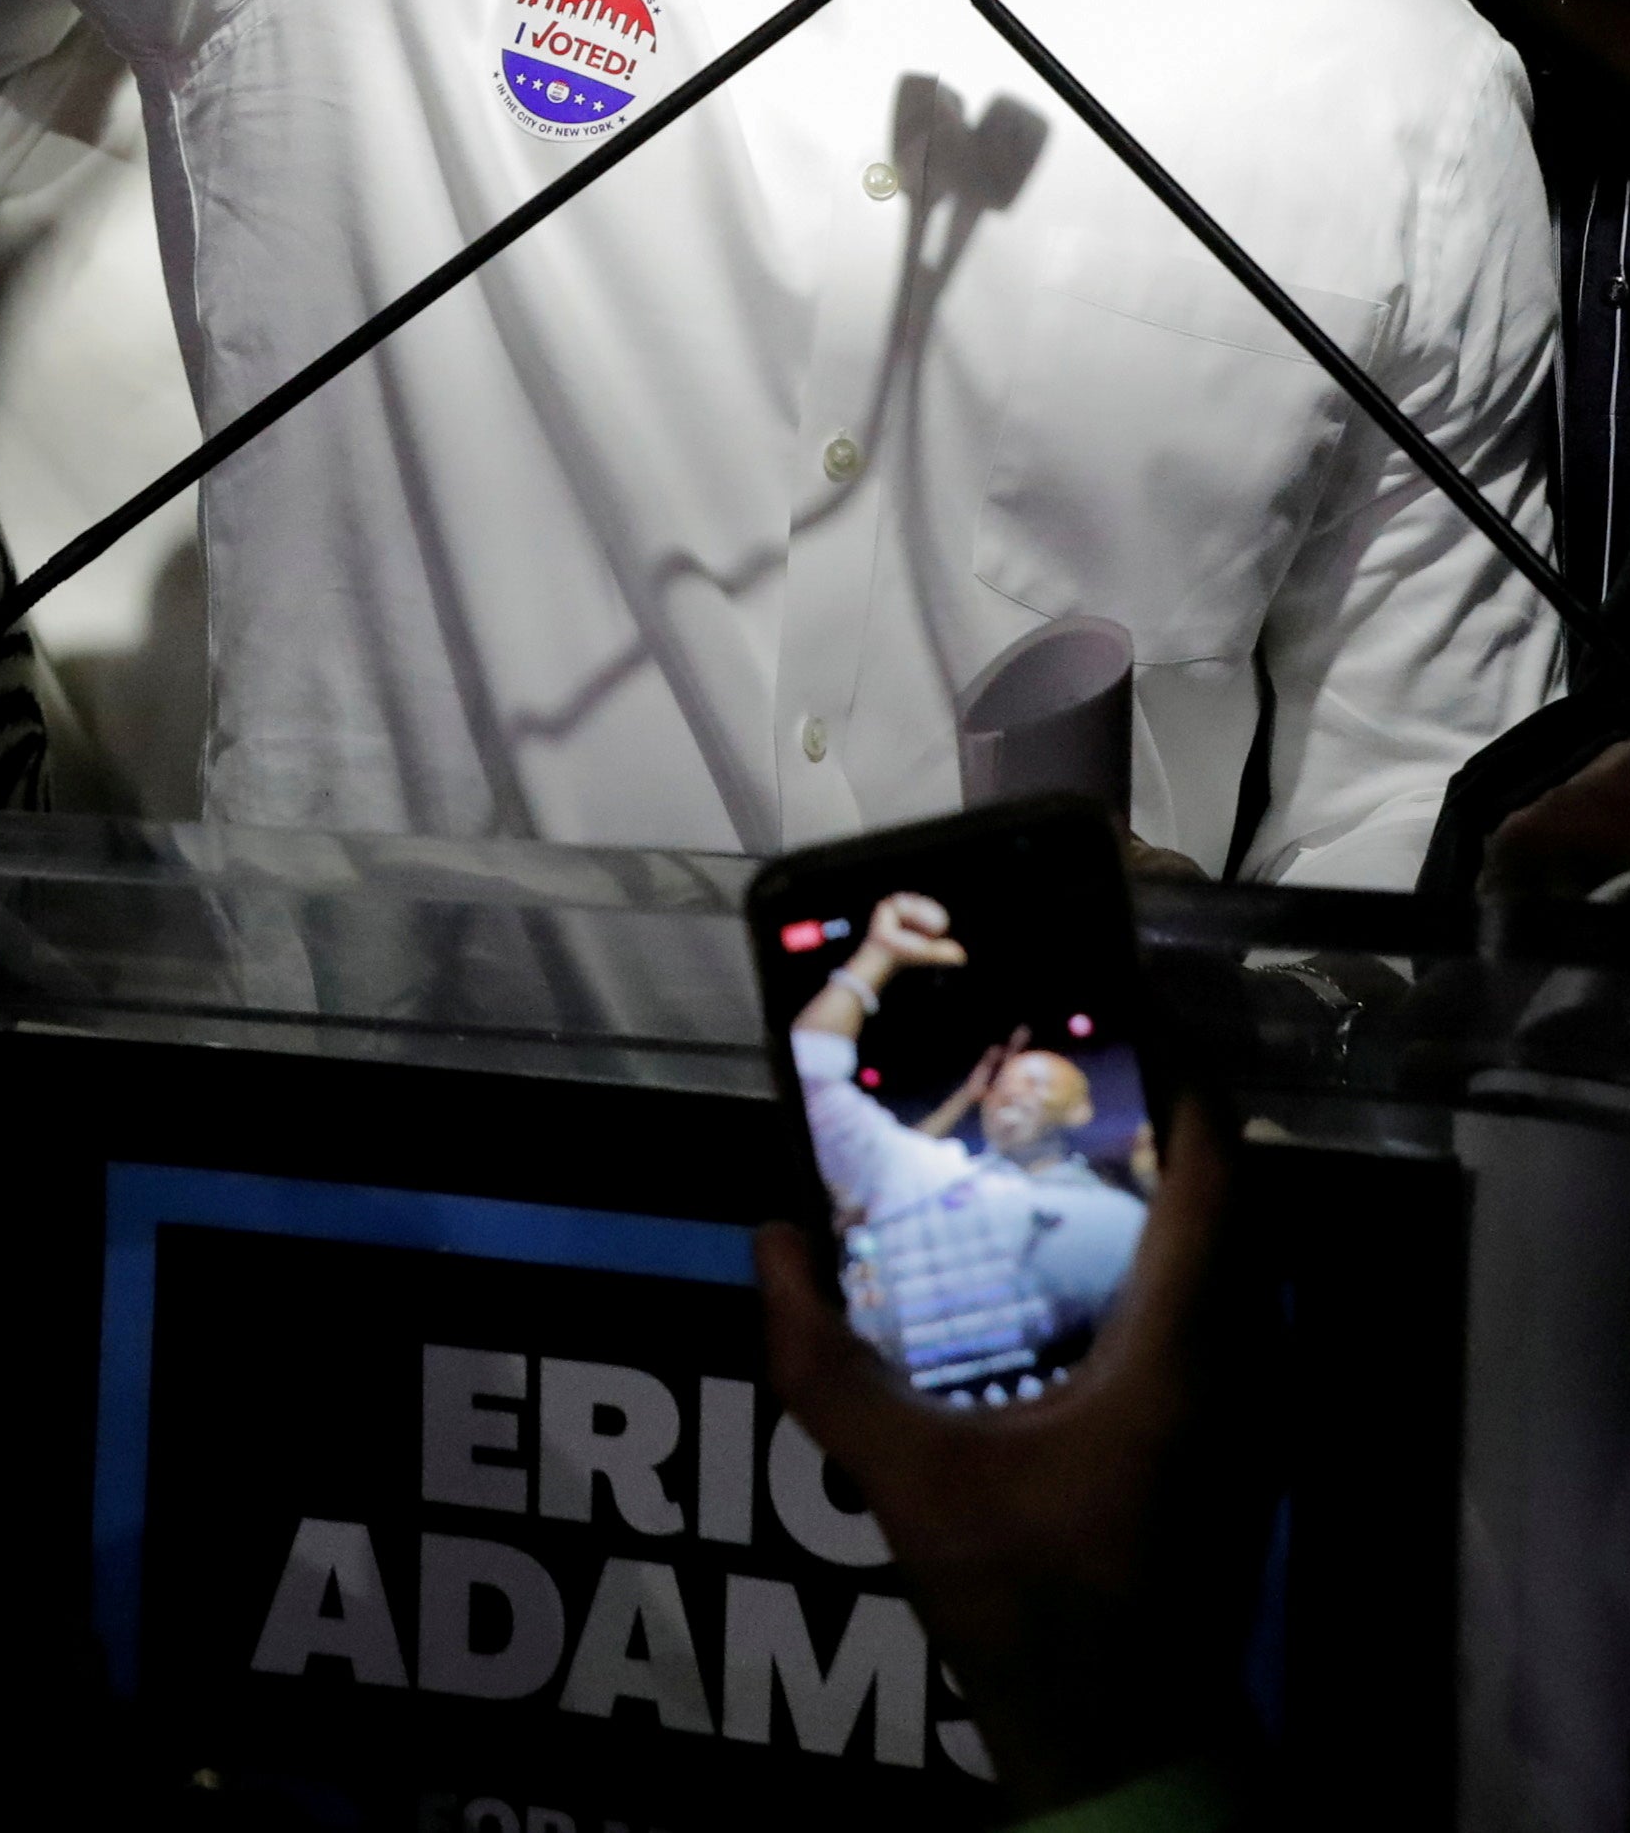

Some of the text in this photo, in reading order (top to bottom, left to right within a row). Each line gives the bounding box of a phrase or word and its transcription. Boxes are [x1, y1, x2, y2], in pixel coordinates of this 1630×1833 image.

[514, 20, 637, 81] I VOTED!
[496, 83, 614, 137] IN THE CITY OF NEW YORK
